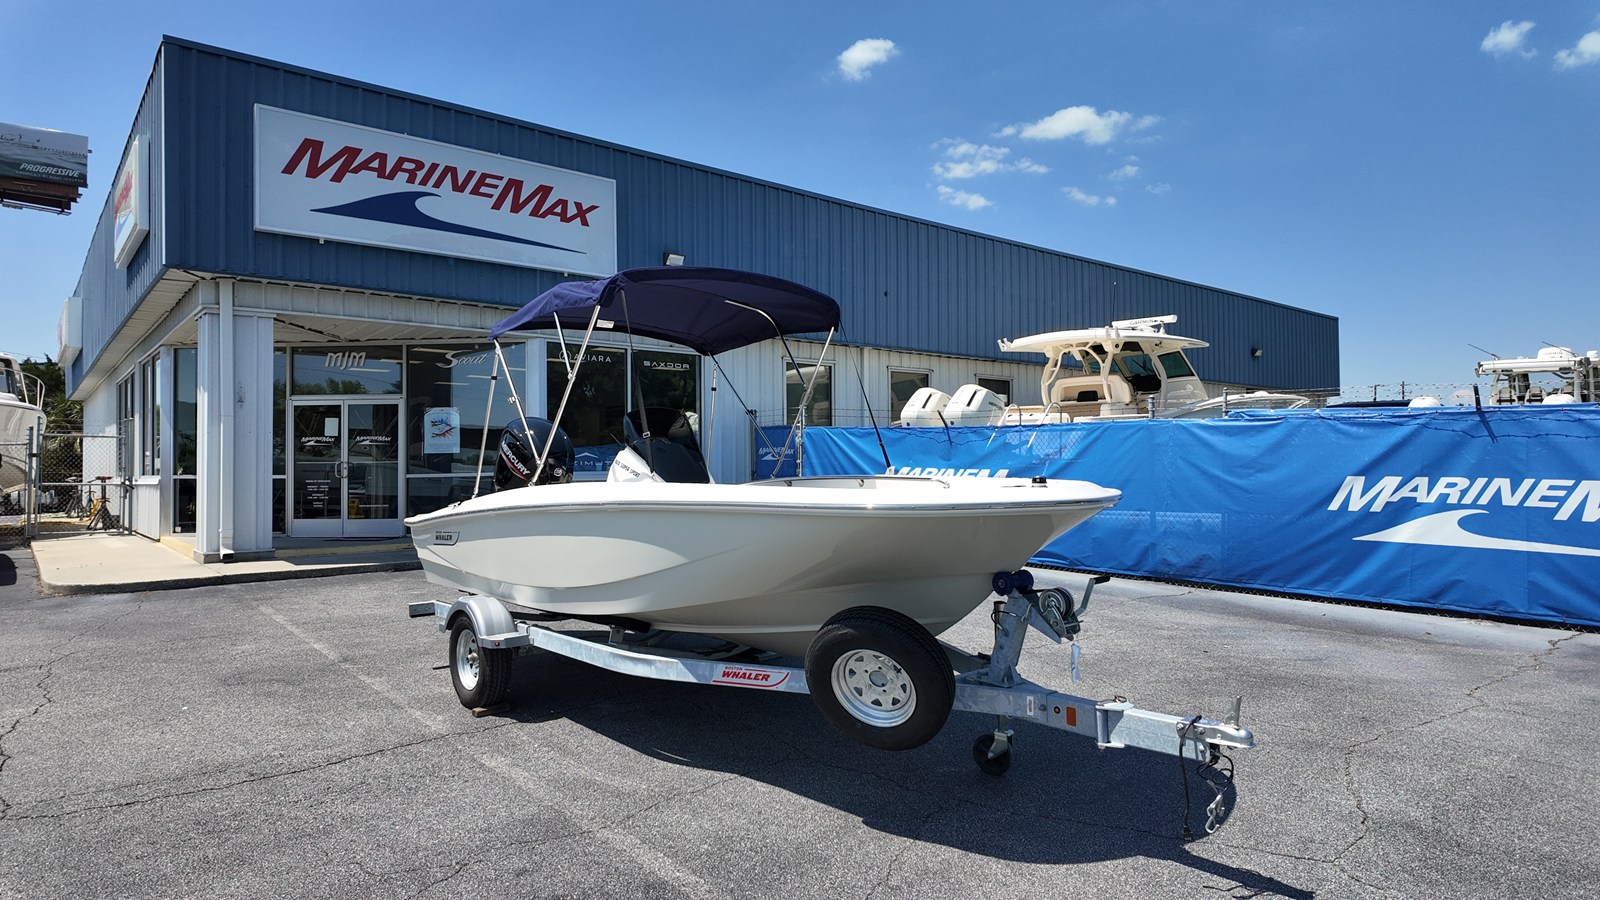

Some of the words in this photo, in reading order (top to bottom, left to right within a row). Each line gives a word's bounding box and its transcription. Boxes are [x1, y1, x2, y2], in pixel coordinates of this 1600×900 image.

[19, 163, 81, 178] PROGRESSIVE
[281, 137, 600, 228] MARINEMAX
[435, 350, 488, 368] Scout
[573, 353, 612, 363] AVIARA
[501, 440, 531, 475] MERCURY
[1327, 475, 1600, 522] MARINEM
[722, 670, 771, 682] WHALER
